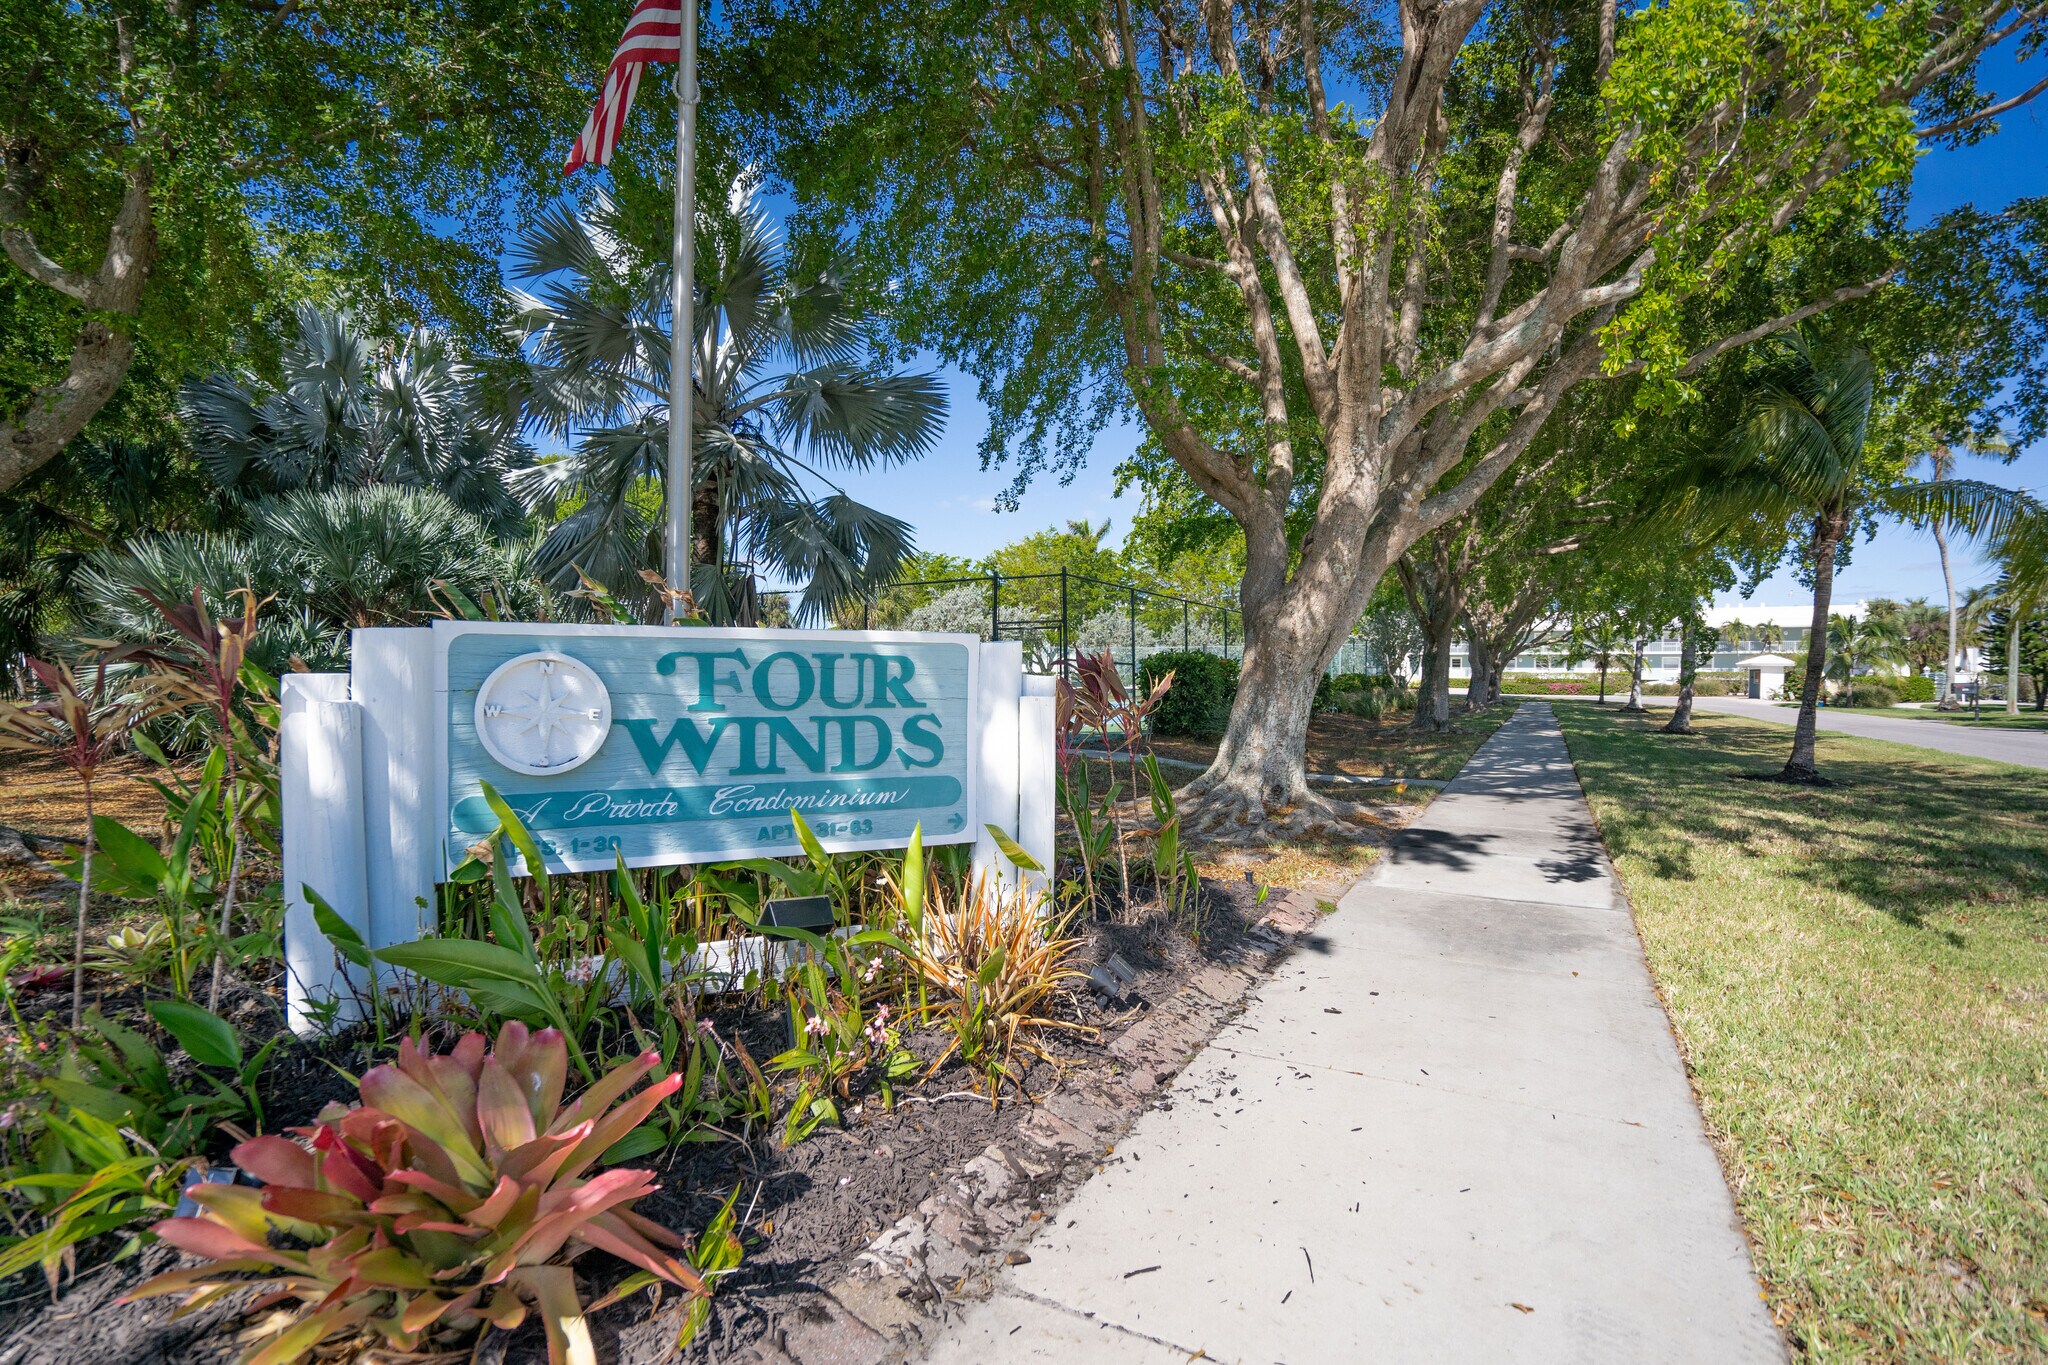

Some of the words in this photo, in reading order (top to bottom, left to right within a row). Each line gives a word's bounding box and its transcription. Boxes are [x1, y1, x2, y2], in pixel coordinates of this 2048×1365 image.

[539, 661, 555, 675] N
[656, 648, 927, 711] FOUR
[484, 704, 501, 718] W
[587, 708, 602, 721] E
[613, 713, 945, 776] WINDS
[511, 797, 552, 823] A
[563, 792, 679, 821] Private
[708, 784, 911, 815] Condominium
[815, 818, 874, 838] 31-63
[570, 835, 622, 854] 1-30
